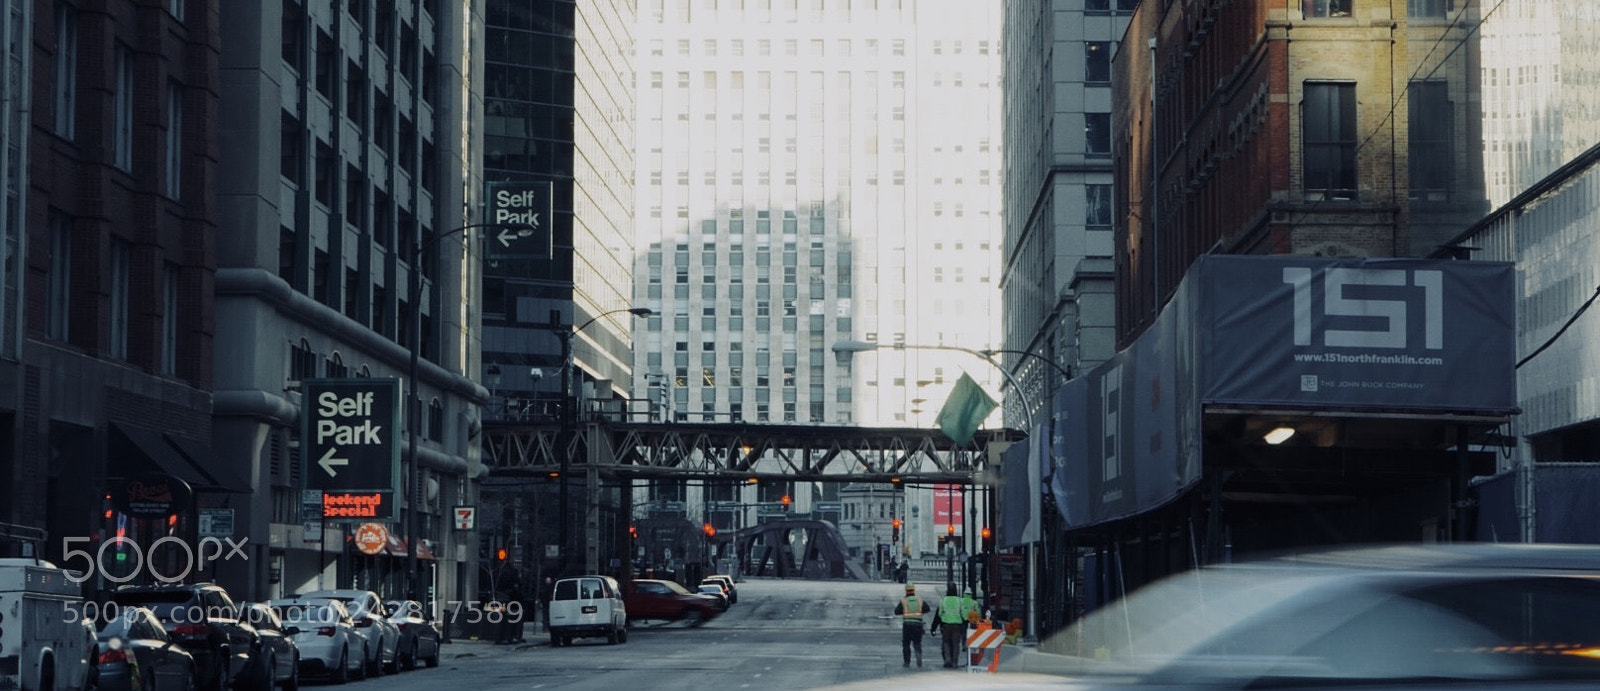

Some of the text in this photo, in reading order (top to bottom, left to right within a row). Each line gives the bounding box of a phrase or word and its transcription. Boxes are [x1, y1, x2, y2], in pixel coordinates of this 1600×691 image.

[496, 190, 534, 208] Self
[496, 209, 540, 229] Park
[1282, 267, 1444, 350] 151
[1294, 353, 1443, 366] www.151northfranklin.com
[1338, 380, 1361, 389] JOHN
[1362, 381, 1385, 390] BUCK
[1387, 382, 1425, 391] COMPANY
[317, 391, 375, 418] Self
[317, 420, 382, 445] Park
